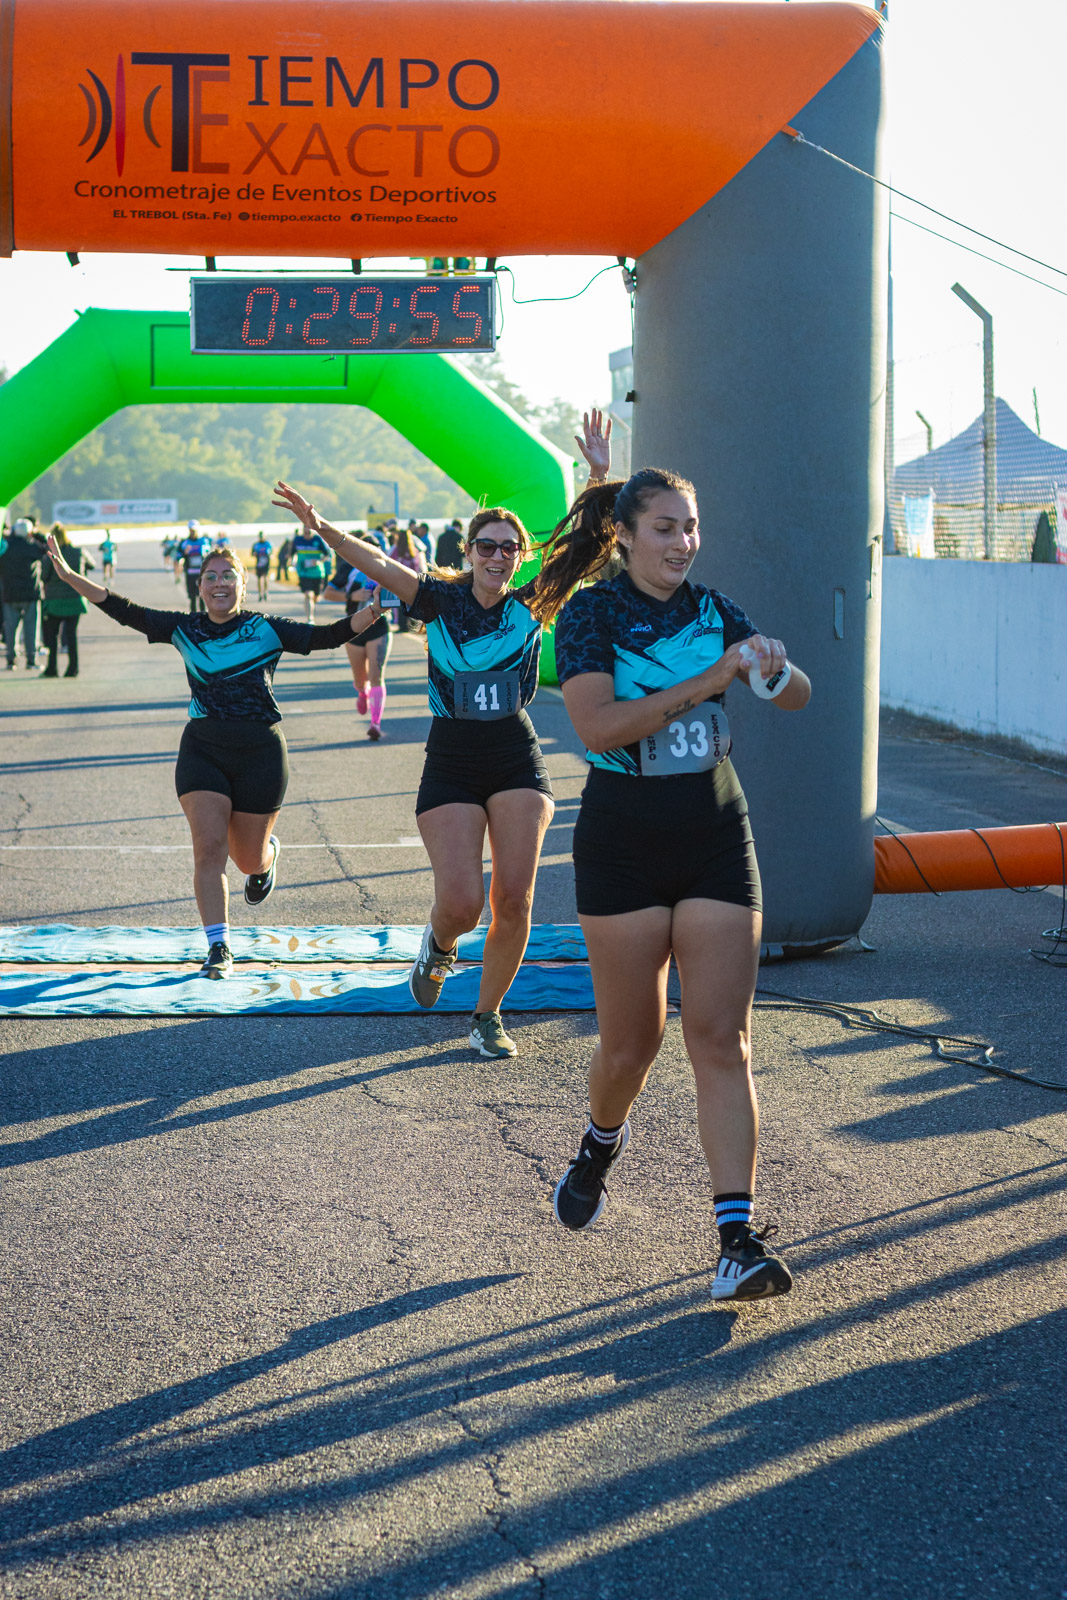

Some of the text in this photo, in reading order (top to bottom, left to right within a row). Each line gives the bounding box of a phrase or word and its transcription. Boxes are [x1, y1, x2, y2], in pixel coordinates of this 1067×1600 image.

[74, 180, 497, 206] Cronometraje de Eventos Deportivos
[113, 210, 458, 224] EL TREBOL (Sta. Fe) tiempo.exacto Tiempo Exacto
[241, 286, 483, 345] 0:29:55
[474, 683, 500, 711] 41
[668, 720, 709, 758] 33
[711, 714, 721, 757] EXACTO
